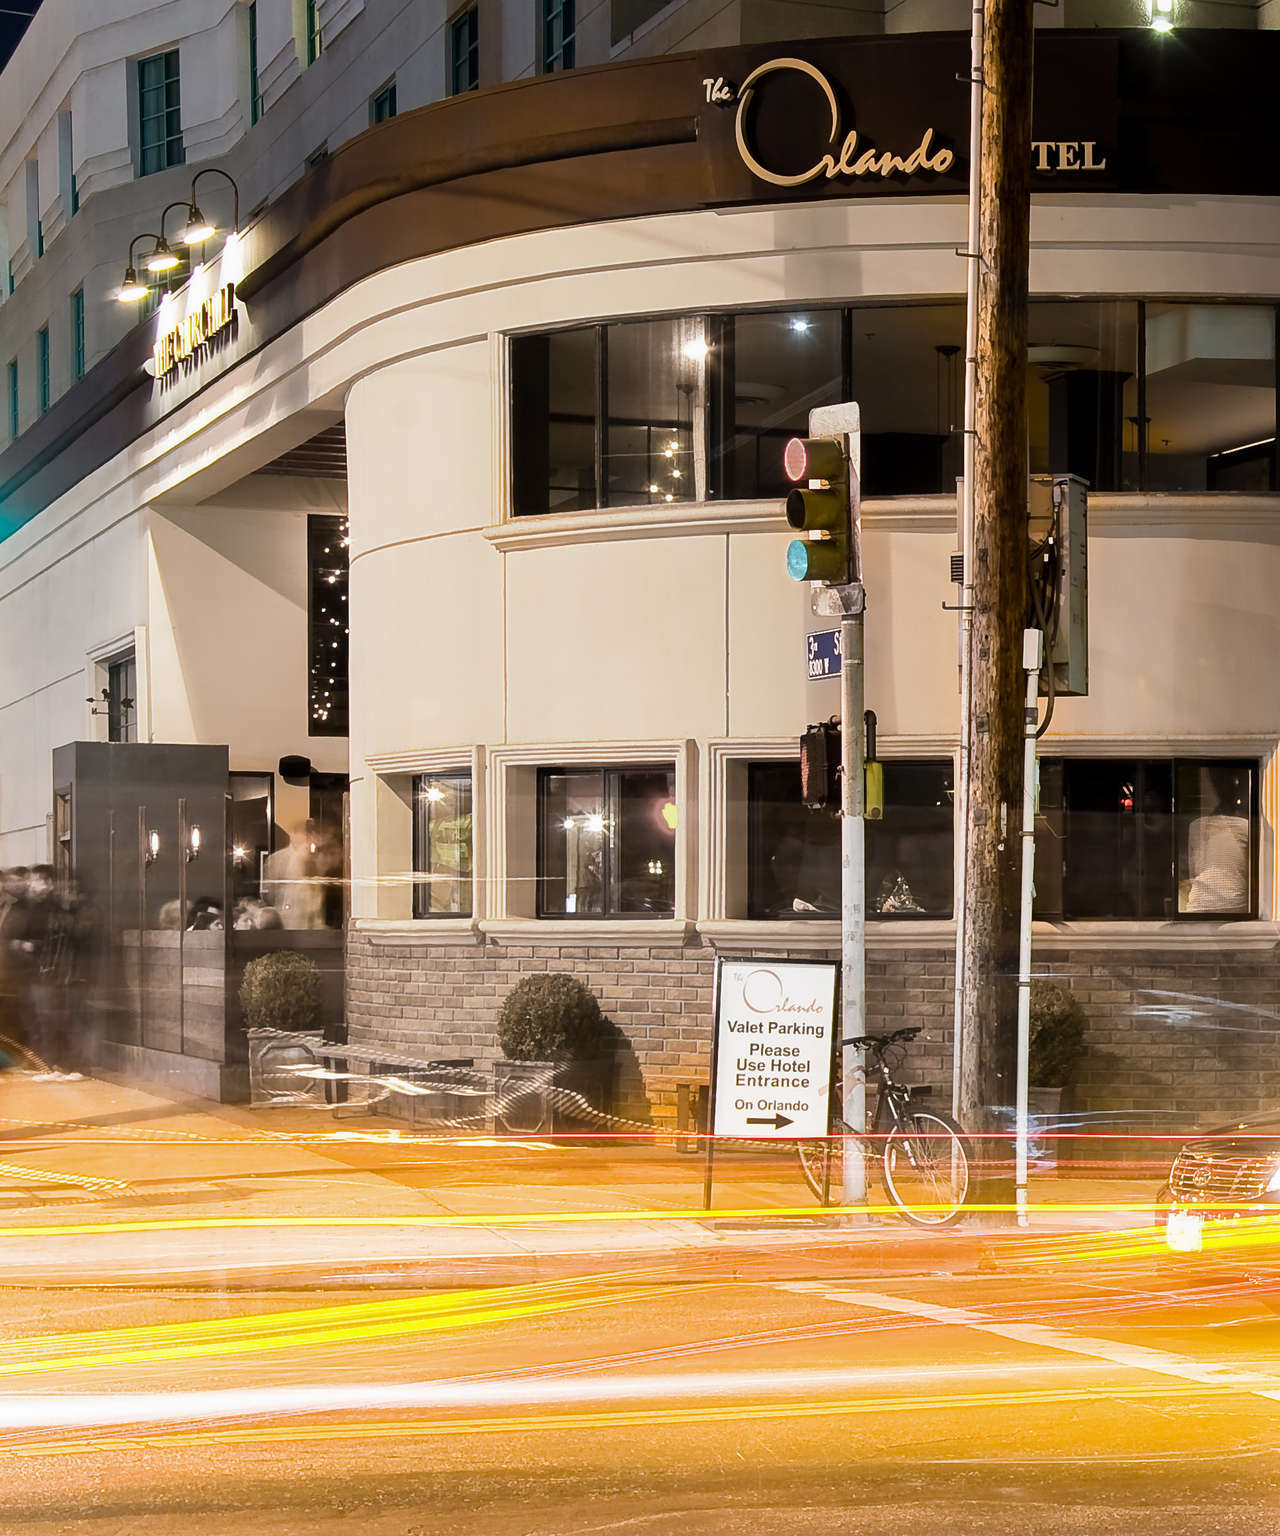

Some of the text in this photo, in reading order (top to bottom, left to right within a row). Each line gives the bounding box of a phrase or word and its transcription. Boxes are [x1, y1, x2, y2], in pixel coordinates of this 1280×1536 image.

[702, 57, 1107, 186] The Orlando TEL
[743, 969, 824, 1013] Orlando
[727, 1020, 825, 1038] Valet Parking
[749, 1043, 800, 1057] Please
[736, 1058, 811, 1073] Use Hotel
[735, 1073, 810, 1089] Entrance
[734, 1098, 809, 1112] On Orlando
